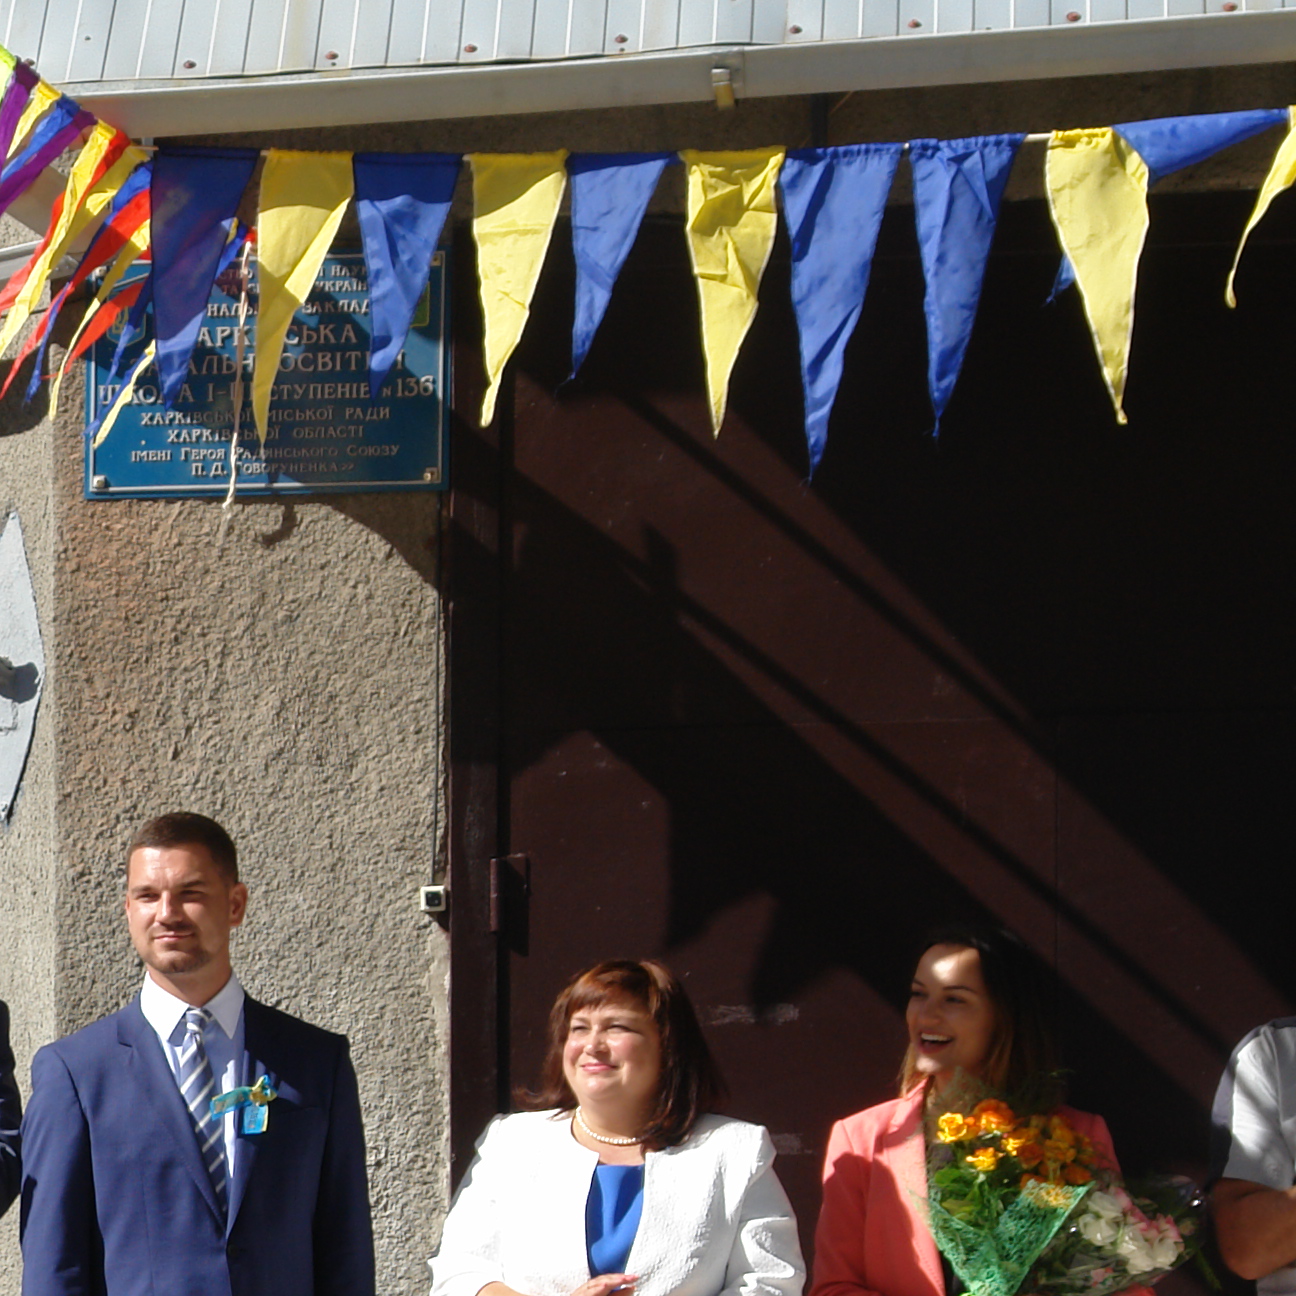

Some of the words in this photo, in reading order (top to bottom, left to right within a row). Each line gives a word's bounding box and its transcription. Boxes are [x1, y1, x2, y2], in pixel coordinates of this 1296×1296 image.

[315, 278, 368, 292] УКРАЇН
[345, 406, 391, 422] РАДИ
[293, 425, 364, 440] ОБЛАСТІ
[131, 450, 172, 463] ІМЕНІ
[191, 462, 207, 476] П.
[210, 462, 228, 477] Д.
